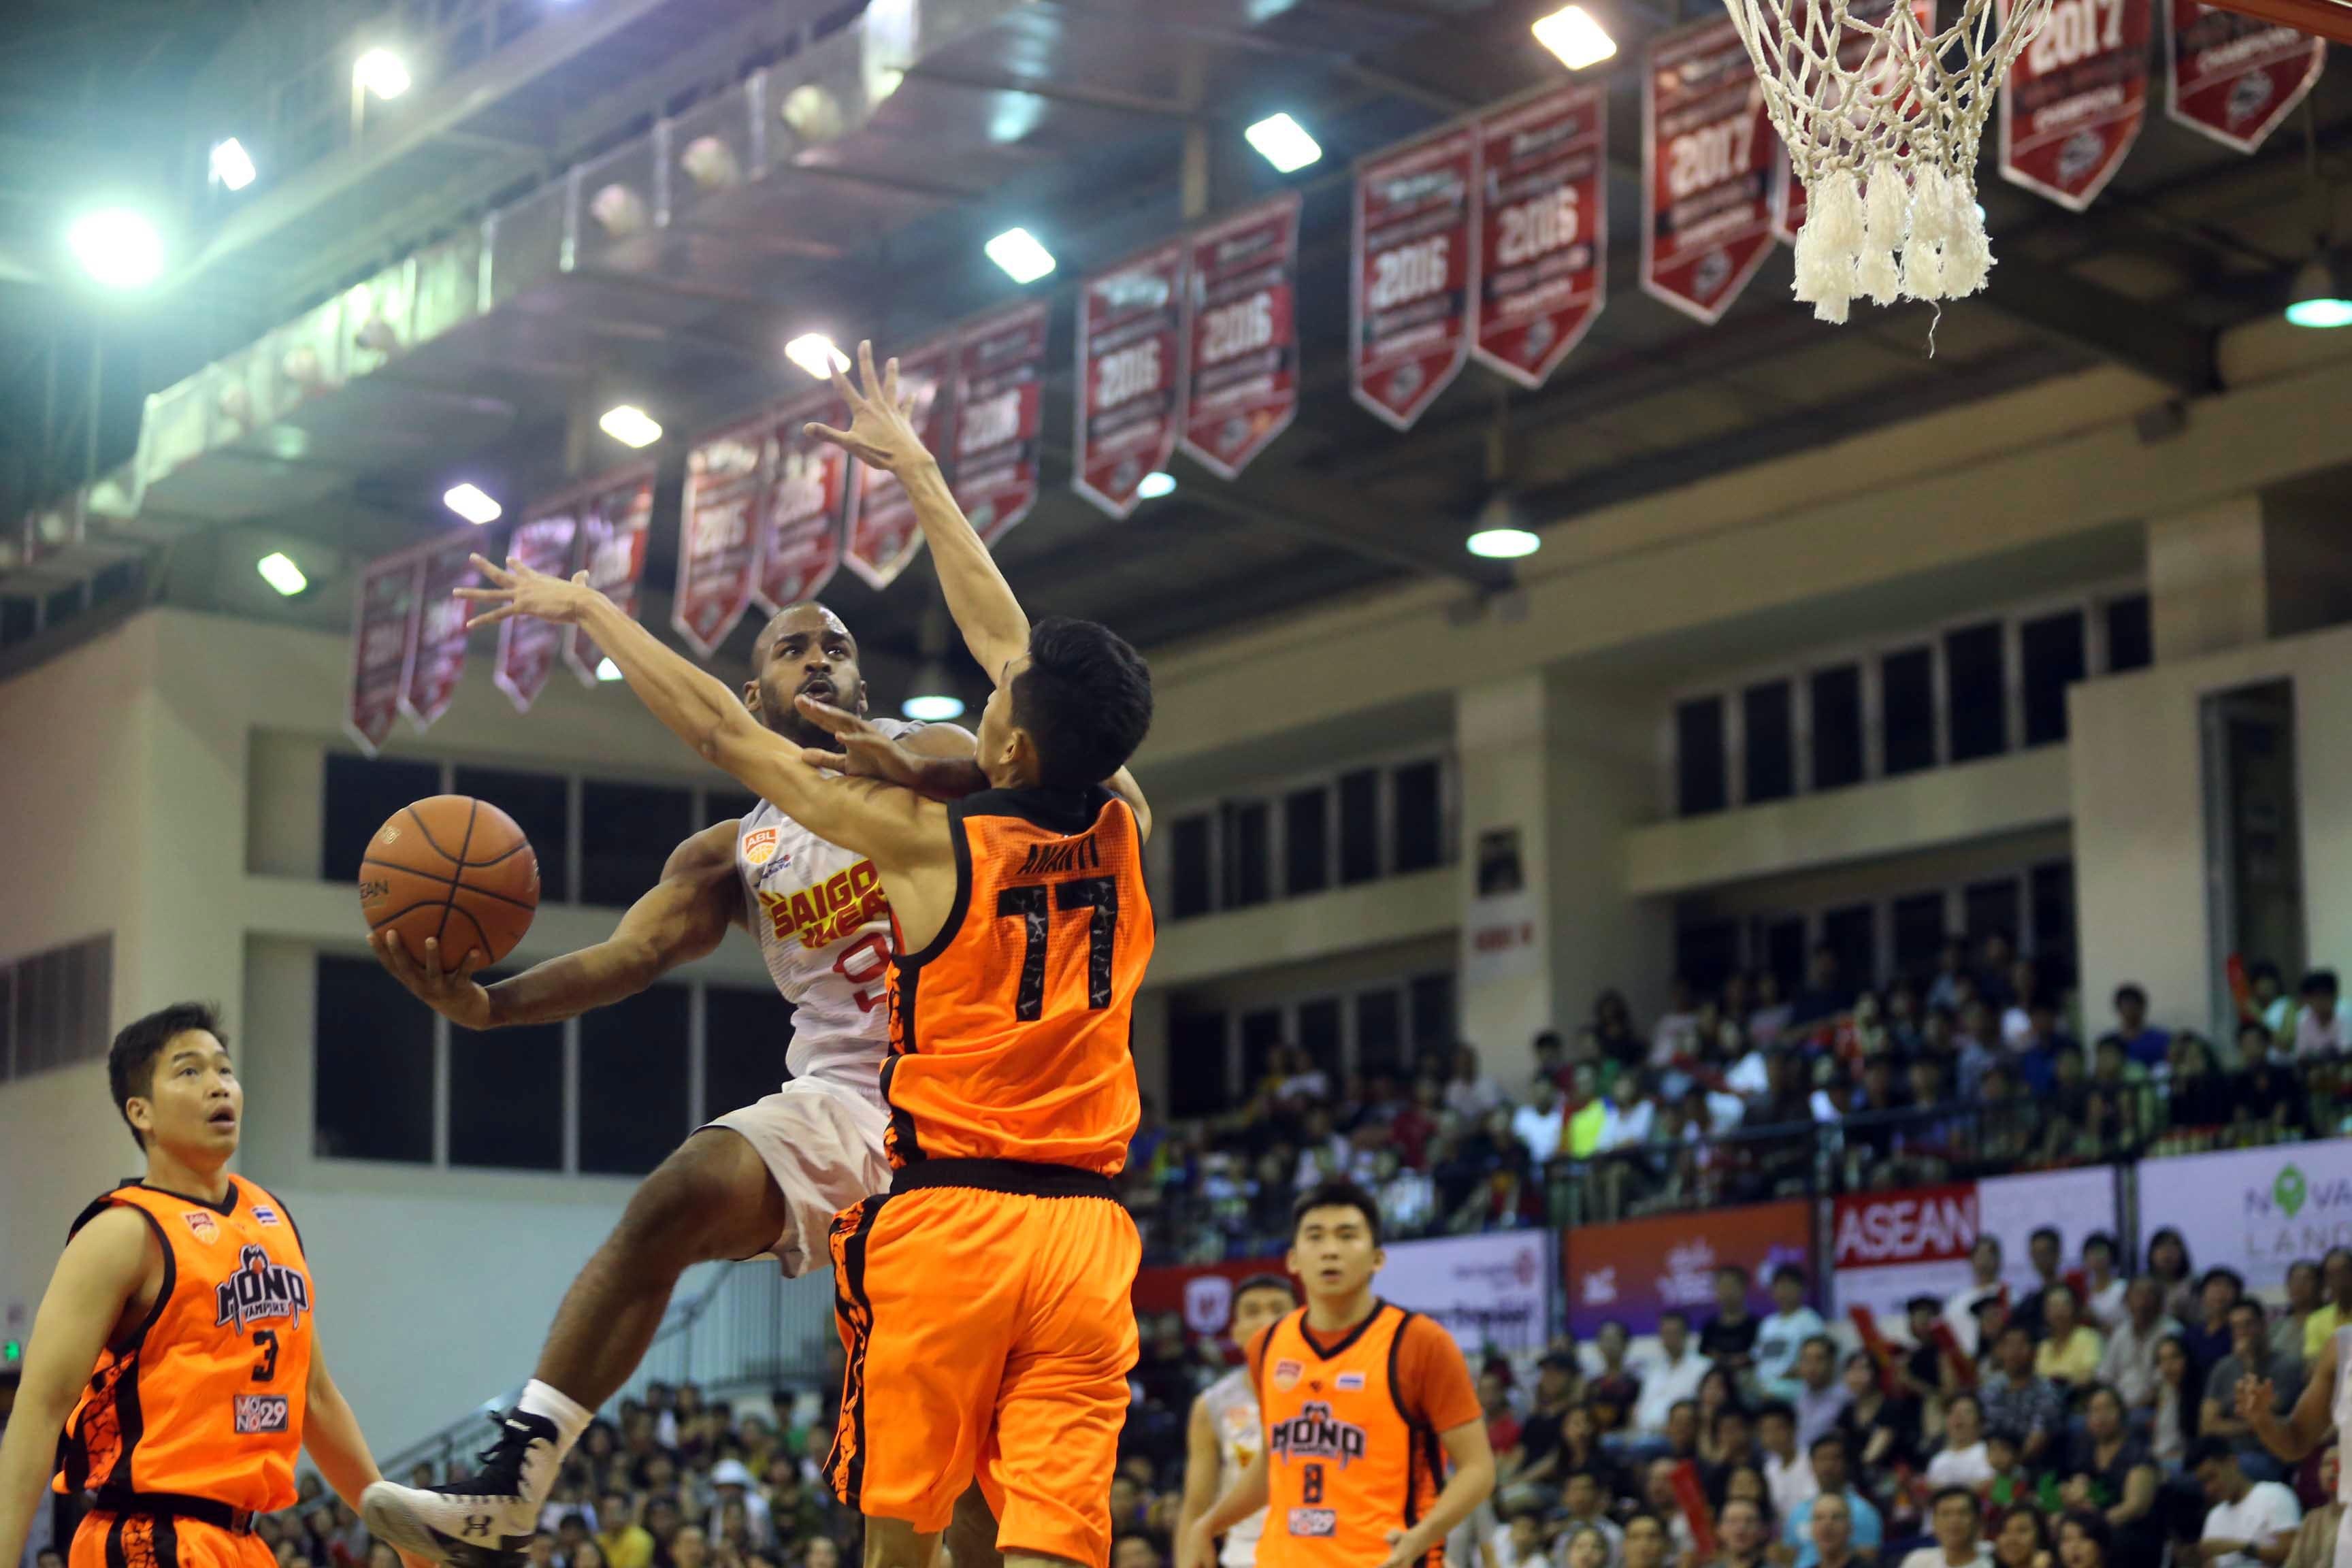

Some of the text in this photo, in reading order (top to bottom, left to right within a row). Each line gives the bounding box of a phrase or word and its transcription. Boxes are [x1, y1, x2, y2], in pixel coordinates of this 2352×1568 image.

[2028, 0, 2124, 75] 2017
[1669, 112, 1754, 197] 2017
[1499, 184, 1580, 265] 2016
[1369, 234, 1451, 309] 2016
[1201, 291, 1274, 364] 2016
[747, 830, 775, 849] ABL
[770, 859, 879, 939] SAIGO
[800, 887, 887, 947] HEA
[996, 875, 1118, 1022] 77
[1835, 1194, 1979, 1262] ASEAN
[216, 1266, 309, 1333] MONO
[250, 1329, 279, 1382] 3
[260, 1401, 287, 1428] 29
[1272, 1417, 1365, 1469] MONO
[1303, 1463, 1323, 1504] 8
